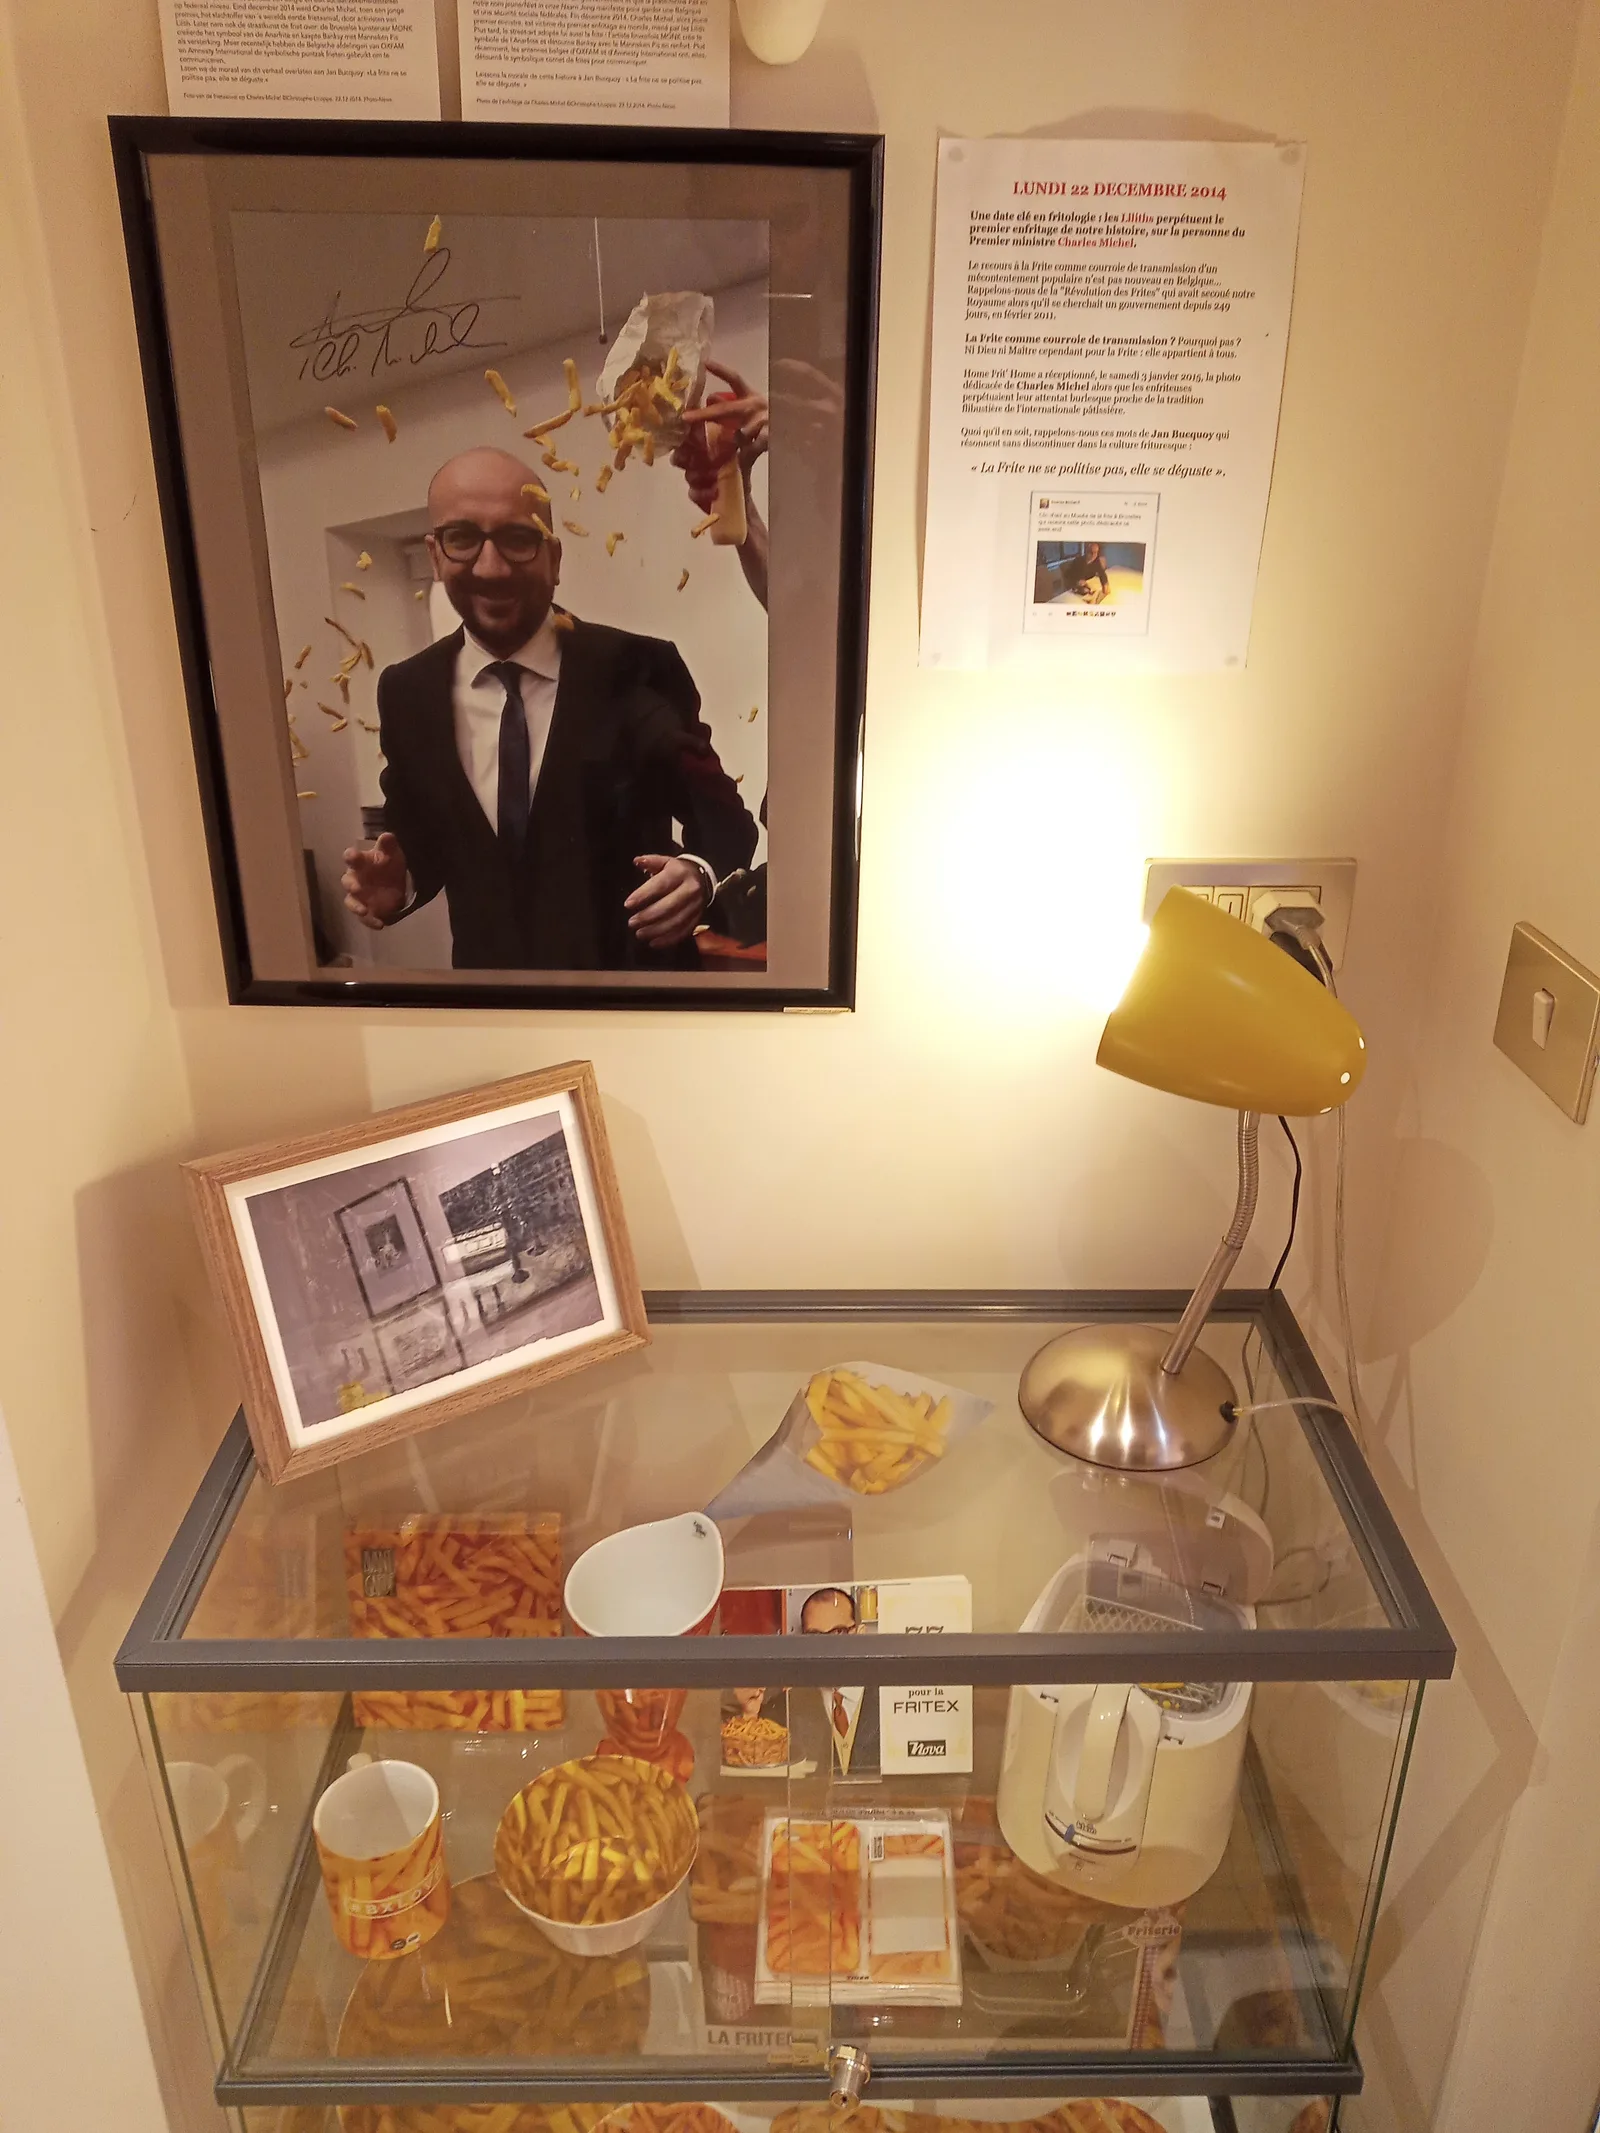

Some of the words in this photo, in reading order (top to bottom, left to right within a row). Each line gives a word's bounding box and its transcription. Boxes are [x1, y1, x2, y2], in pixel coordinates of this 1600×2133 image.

[1013, 181, 1066, 196] LUNDI
[1070, 184, 1090, 196] 22
[1094, 182, 1187, 198] DECEMBRE
[1190, 186, 1227, 201] 2014
[970, 210, 991, 221] Une
[993, 210, 1014, 221] date
[1016, 210, 1031, 221] clé
[1034, 214, 1046, 222] en
[1048, 211, 1096, 224] fritologie
[1104, 212, 1119, 222] les
[1121, 212, 1154, 223] Liliths
[1156, 213, 1213, 225] perpétuent
[1214, 214, 1224, 224] le
[969, 222, 1010, 235] premier
[1012, 224, 1058, 236] enfritage
[1060, 224, 1073, 234] de
[1075, 226, 1104, 235] notre
[1106, 225, 1149, 238] histoire,
[1151, 228, 1168, 236] sur
[1170, 226, 1180, 236] la
[1182, 228, 1230, 238] personne
[1232, 226, 1246, 238] du
[969, 236, 1010, 246] Premier
[1012, 236, 1056, 246] ministre
[1058, 236, 1097, 247] Charles
[1099, 238, 1137, 248] Michel.
[968, 260, 978, 270] Le
[980, 262, 1012, 271] recours
[1021, 260, 1030, 270] la
[1032, 260, 1052, 271] Frite
[1054, 263, 1086, 272] comme
[1088, 262, 1126, 272] courroie
[1127, 262, 1138, 272] de
[1140, 262, 1196, 274] transmission
[1198, 263, 1218, 274] d'un
[968, 272, 1039, 283] mécontentement
[1042, 273, 1083, 288] populaire
[1085, 274, 1104, 285] n'est
[1107, 276, 1122, 286] pas
[1124, 276, 1162, 286] nouveau
[1163, 277, 1174, 286] en
[1176, 276, 1222, 288] Belgique...
[968, 285, 1036, 296] Rappelons-nous
[1038, 285, 1048, 296] de
[1050, 284, 1058, 296] la
[1060, 286, 1112, 297] "Révolution
[1114, 286, 1128, 296] des
[1130, 286, 1160, 298] Frites"
[1162, 288, 1176, 300] qui
[1178, 288, 1199, 298] avait
[1201, 289, 1230, 299] secoué
[1232, 289, 1256, 299] notre
[966, 297, 1006, 308] Royaume
[1008, 297, 1029, 308] alors
[1031, 297, 1050, 310] qu'il
[1052, 300, 1060, 308] se
[1062, 298, 1103, 309] cherchait
[1105, 301, 1117, 309] un
[1119, 301, 1181, 311] gouvernement
[1183, 300, 1212, 312] depuis
[1214, 302, 1231, 312] 249
[965, 309, 990, 320] jours,
[992, 311, 1002, 319] en
[1004, 309, 1032, 320] février
[1034, 312, 1056, 320] 2011.
[965, 333, 978, 343] La
[980, 332, 1003, 343] Frite
[1004, 335, 1040, 344] comme
[1043, 334, 1086, 344] courroie
[1088, 334, 1100, 344] de
[1102, 336, 1168, 346] transmission
[1178, 336, 1218, 348] Pourquoi
[1220, 338, 1234, 348] pas
[964, 345, 975, 354] Ni
[977, 345, 996, 355] Dieu
[998, 345, 1006, 355] ni
[1038, 346, 1083, 358] cependant
[1085, 348, 1105, 358] pour
[1108, 347, 1116, 356] la
[1118, 347, 1138, 357] Frite
[1145, 348, 1160, 358] elle
[1162, 348, 1206, 360] appartient
[1216, 349, 1237, 358] tous.
[964, 369, 990, 378] Home
[992, 368, 1008, 378] Frit'
[1010, 369, 1037, 378] Home
[1045, 369, 1098, 380] réceptionné,
[1100, 370, 1106, 380] le
[1109, 370, 1140, 380] samedi
[1148, 370, 1179, 382] janvier
[1180, 373, 1204, 382] 2015,
[1206, 372, 1214, 382] la
[1216, 372, 1241, 384] photo
[962, 380, 1002, 390] dédicacée
[1004, 380, 1014, 390] de
[1016, 380, 1054, 390] Charles
[1056, 381, 1090, 391] Michel
[1091, 382, 1112, 392] alors
[1114, 384, 1130, 394] que
[1132, 382, 1144, 392] les
[1146, 383, 1192, 392] enfriteuses
[962, 392, 1014, 402] perpétuaient
[1016, 392, 1033, 402] leur
[1034, 392, 1068, 402] attentat
[1070, 393, 1112, 404] burlesque
[1114, 394, 1142, 404] proche
[1144, 394, 1156, 404] de
[1156, 394, 1165, 404] la
[1166, 394, 1204, 404] tradition
[961, 426, 981, 438] Quoi
[983, 426, 1000, 438] qu'il
[1002, 428, 1012, 436] en
[1014, 426, 1032, 437] soit,
[1034, 427, 1099, 438] rappelons-nous
[1116, 430, 1137, 438] mots
[1139, 428, 1150, 438] de
[1151, 430, 1169, 438] Jan
[1172, 430, 1214, 442] Bucquoy
[1216, 430, 1230, 442] qui
[961, 438, 1000, 448] résonnent
[1002, 440, 1020, 448] sans
[1022, 438, 1075, 448] discontinuer
[1078, 439, 1098, 448] dans
[1109, 440, 1139, 450] culture
[1140, 440, 1188, 452] frituresque
[980, 462, 994, 474] La
[998, 461, 1024, 474] Frite
[1028, 464, 1042, 474] ne
[1044, 464, 1056, 474] se
[1058, 462, 1101, 476] politise
[1103, 464, 1128, 477] pas,
[1130, 463, 1150, 476] elle
[1153, 466, 1166, 476] se
[1168, 464, 1212, 479] déguste
[908, 1688, 932, 1698] pour
[934, 1686, 944, 1696] la
[893, 1700, 959, 1714] FRITEX
[908, 1741, 946, 1756] Nova
[708, 2030, 730, 2046] LA
